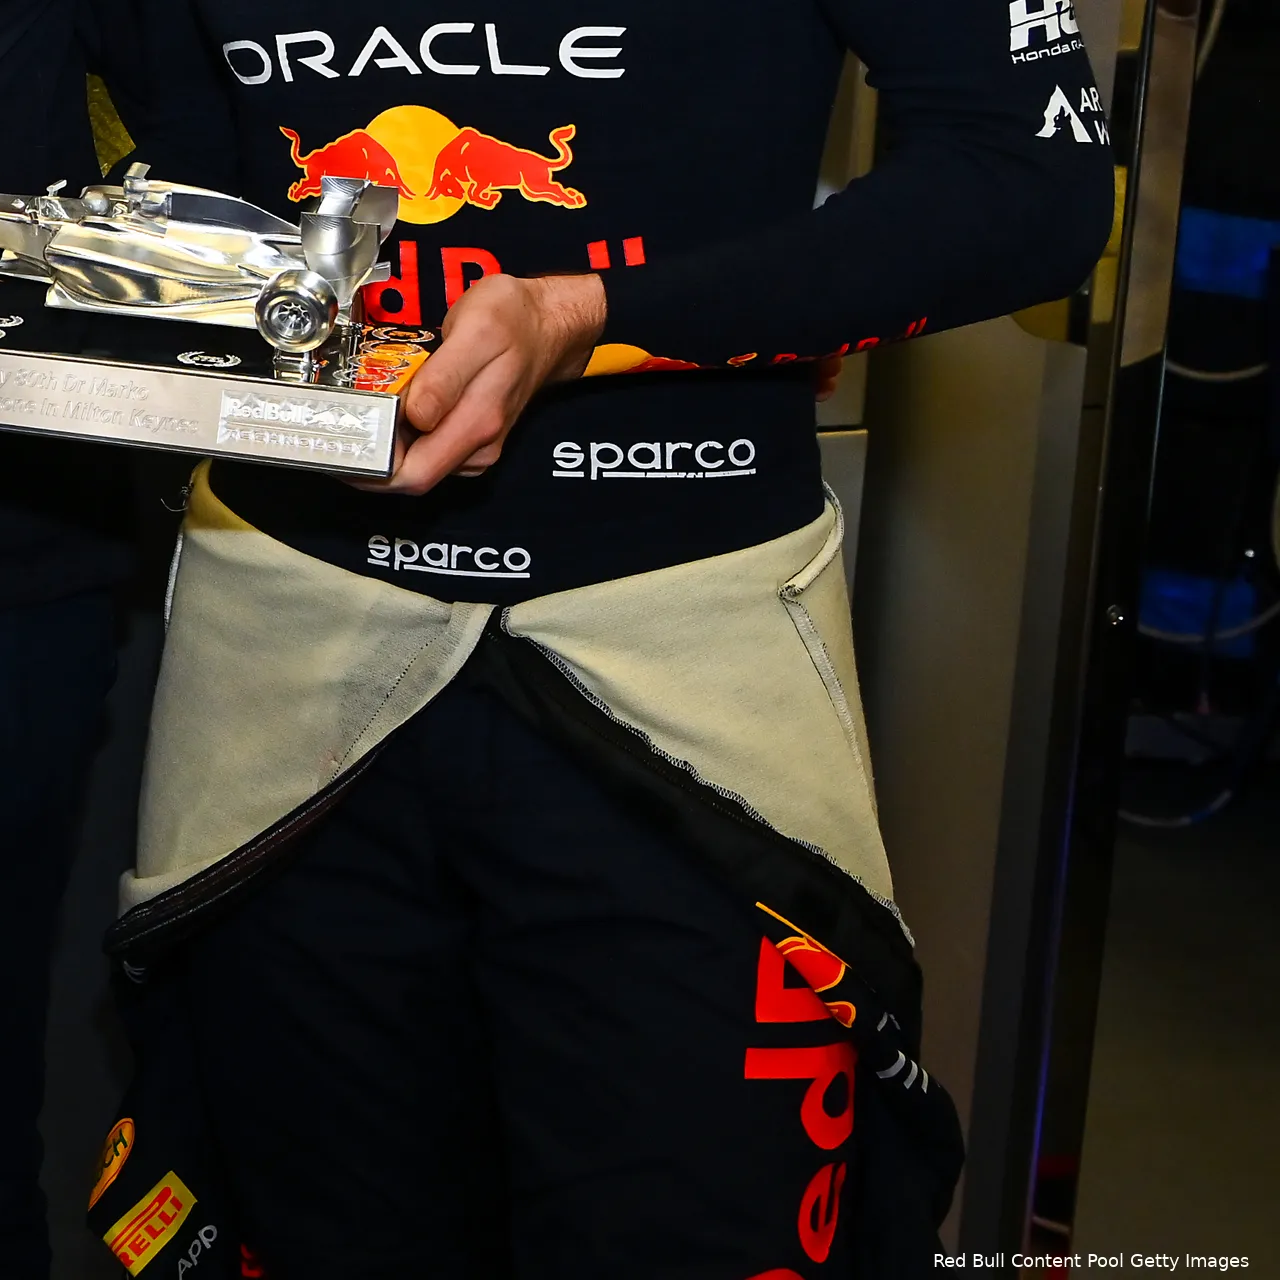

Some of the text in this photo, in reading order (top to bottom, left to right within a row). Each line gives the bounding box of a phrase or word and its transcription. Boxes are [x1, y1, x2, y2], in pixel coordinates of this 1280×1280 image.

[223, 22, 627, 85] ORACLE
[552, 438, 756, 480] sparco
[366, 534, 532, 574] sparco
[118, 1196, 184, 1269] RELLI
